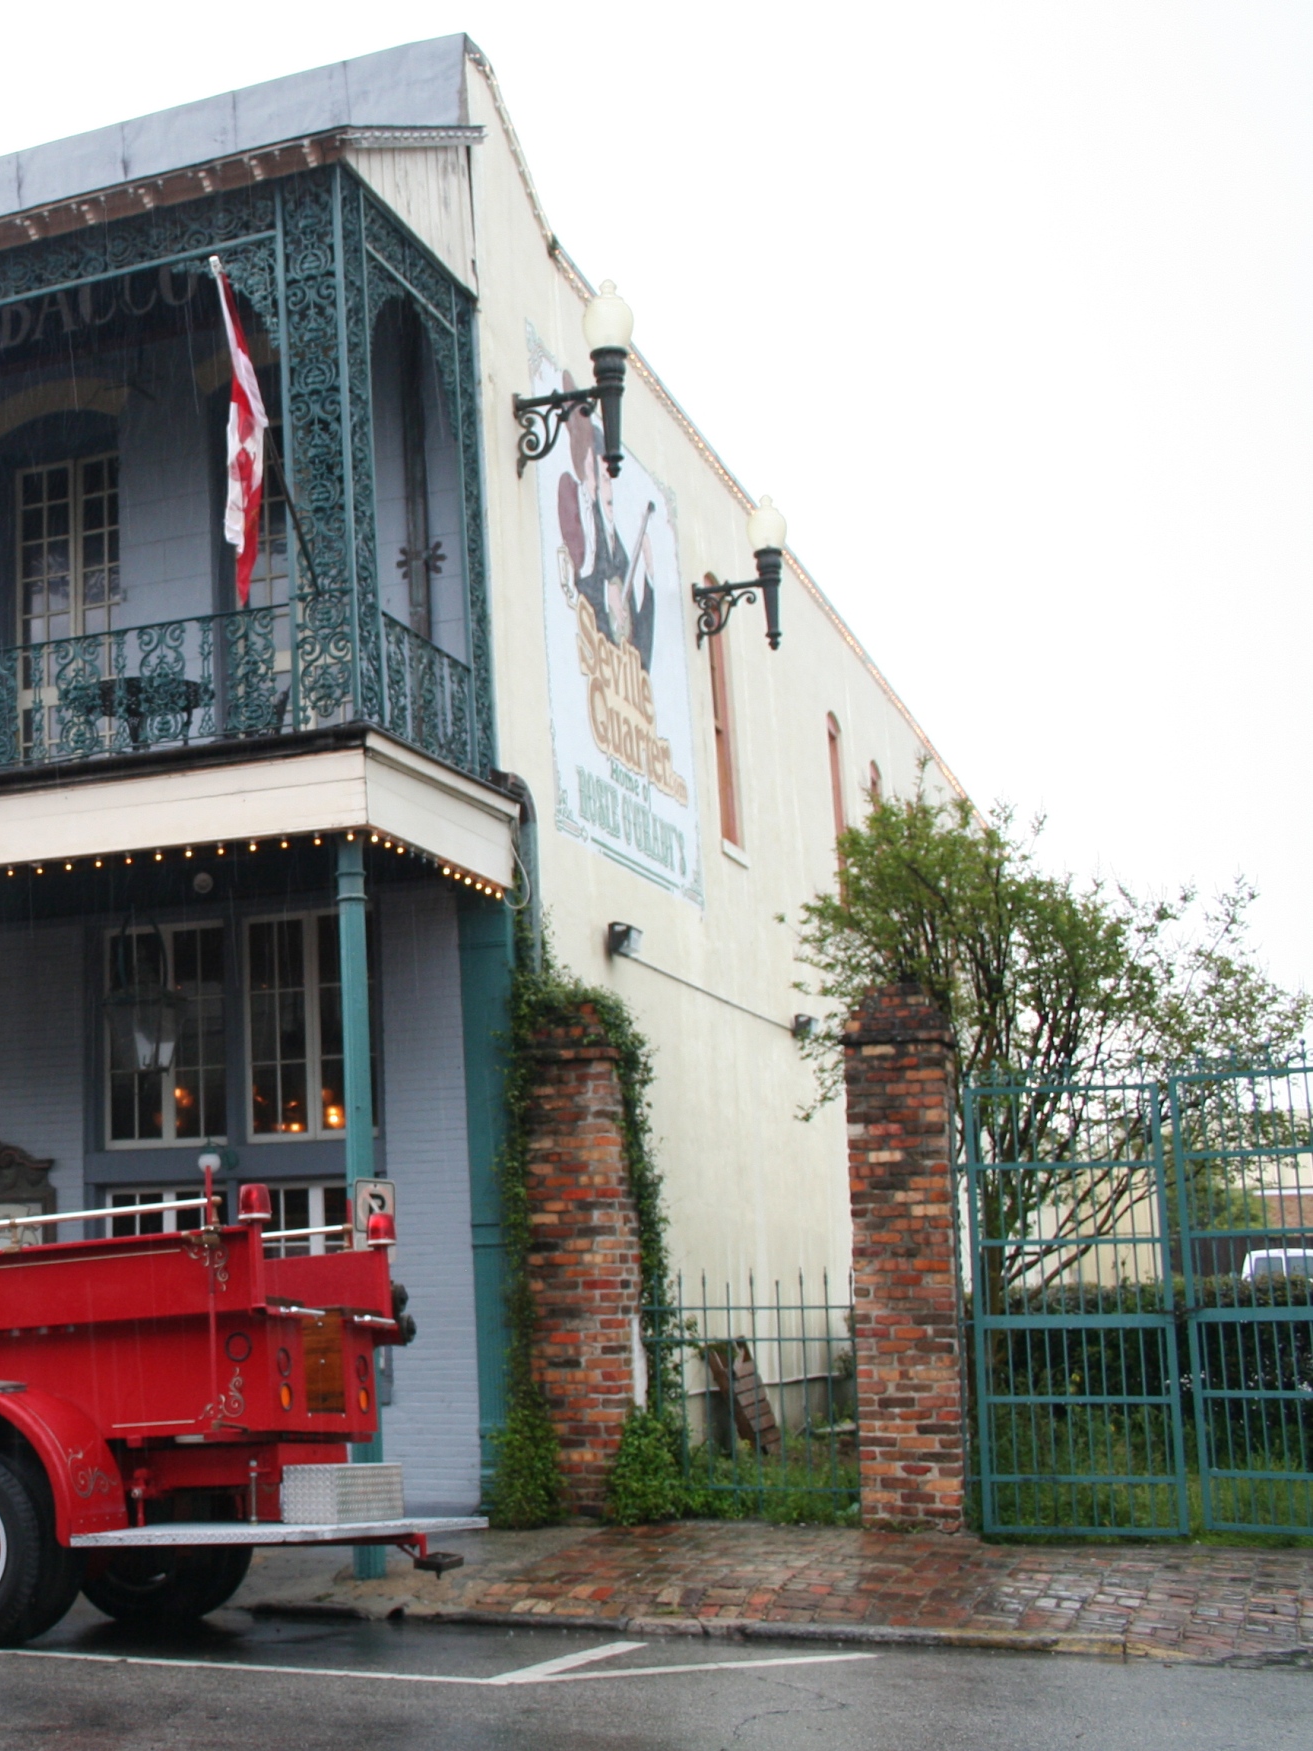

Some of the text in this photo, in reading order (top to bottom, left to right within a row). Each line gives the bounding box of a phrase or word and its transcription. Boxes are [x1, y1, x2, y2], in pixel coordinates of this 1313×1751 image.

[576, 597, 655, 727] Seville
[575, 764, 687, 878] ROSIE O'GRADY'S
[610, 758, 652, 814] Home of
